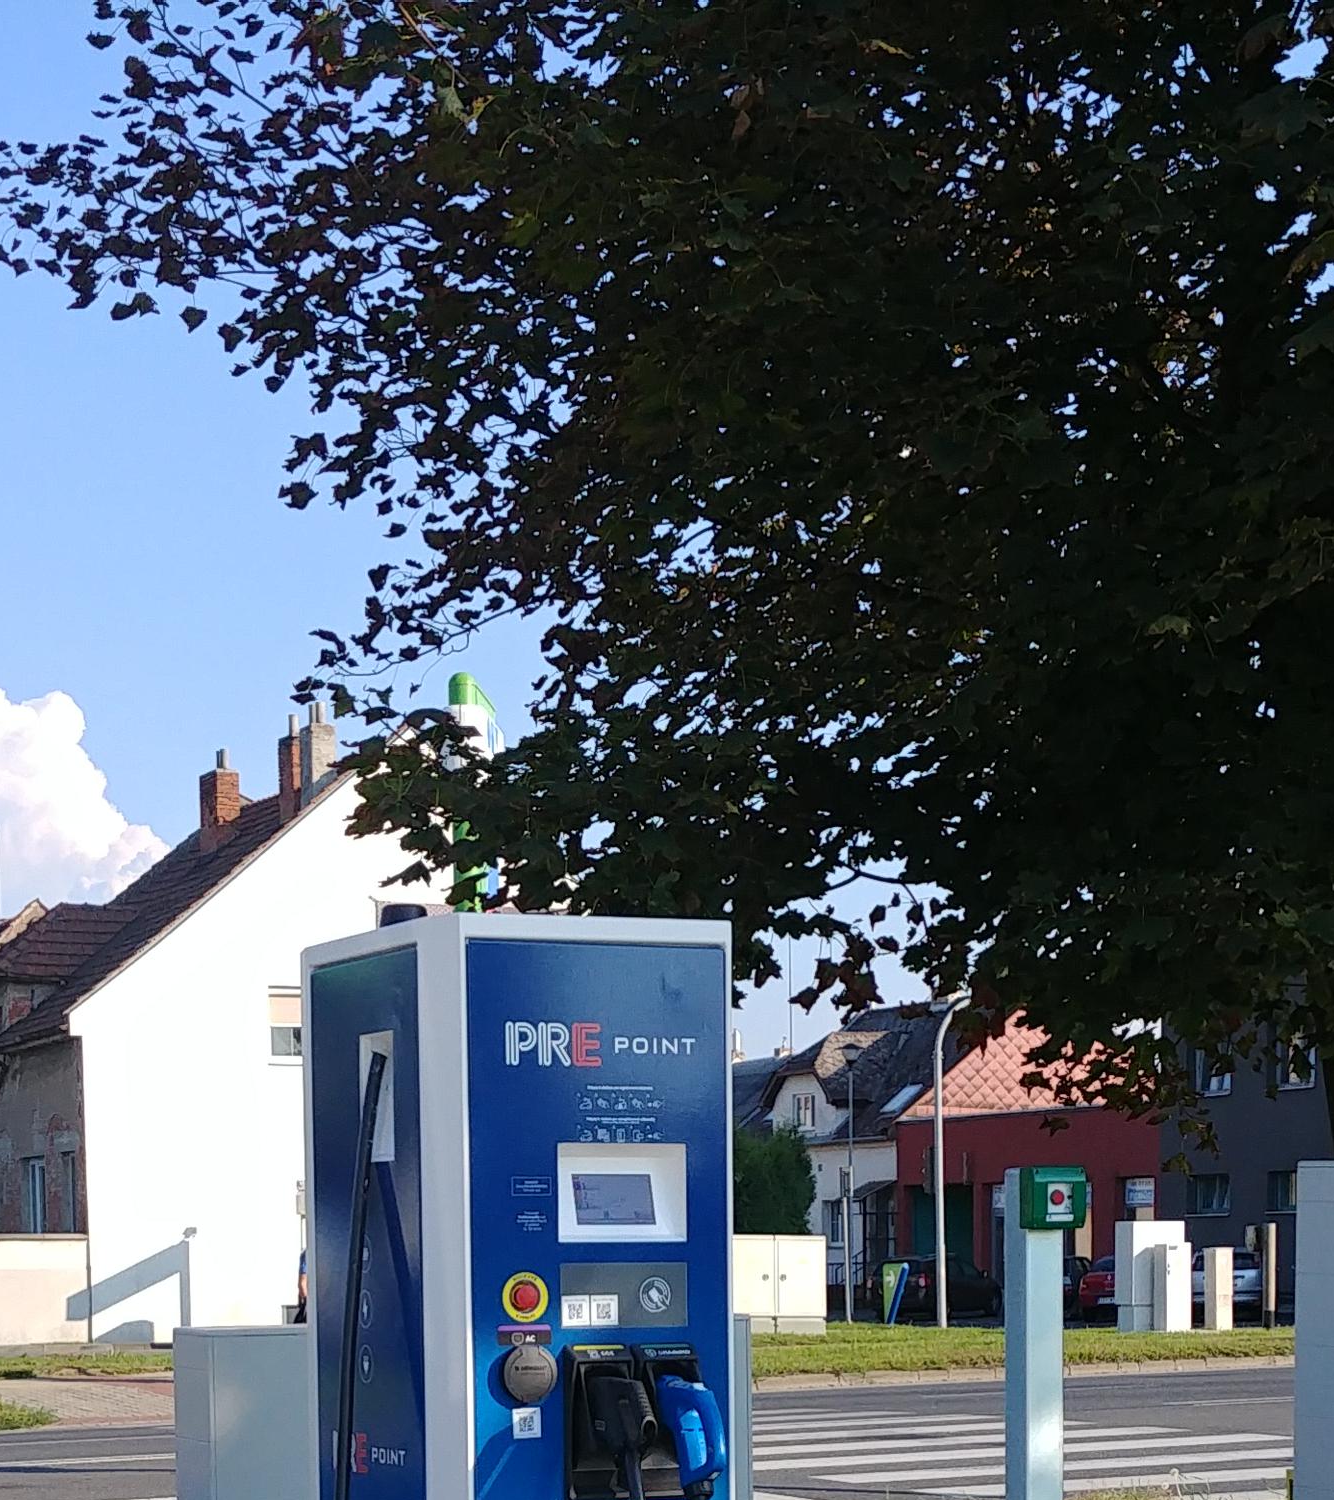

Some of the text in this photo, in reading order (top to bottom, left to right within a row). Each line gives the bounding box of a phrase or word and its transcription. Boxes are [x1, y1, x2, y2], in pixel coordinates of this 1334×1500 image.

[505, 1021, 696, 1067] PRE POINT
[525, 1334, 537, 1343] AC
[371, 1447, 406, 1466] POINT
